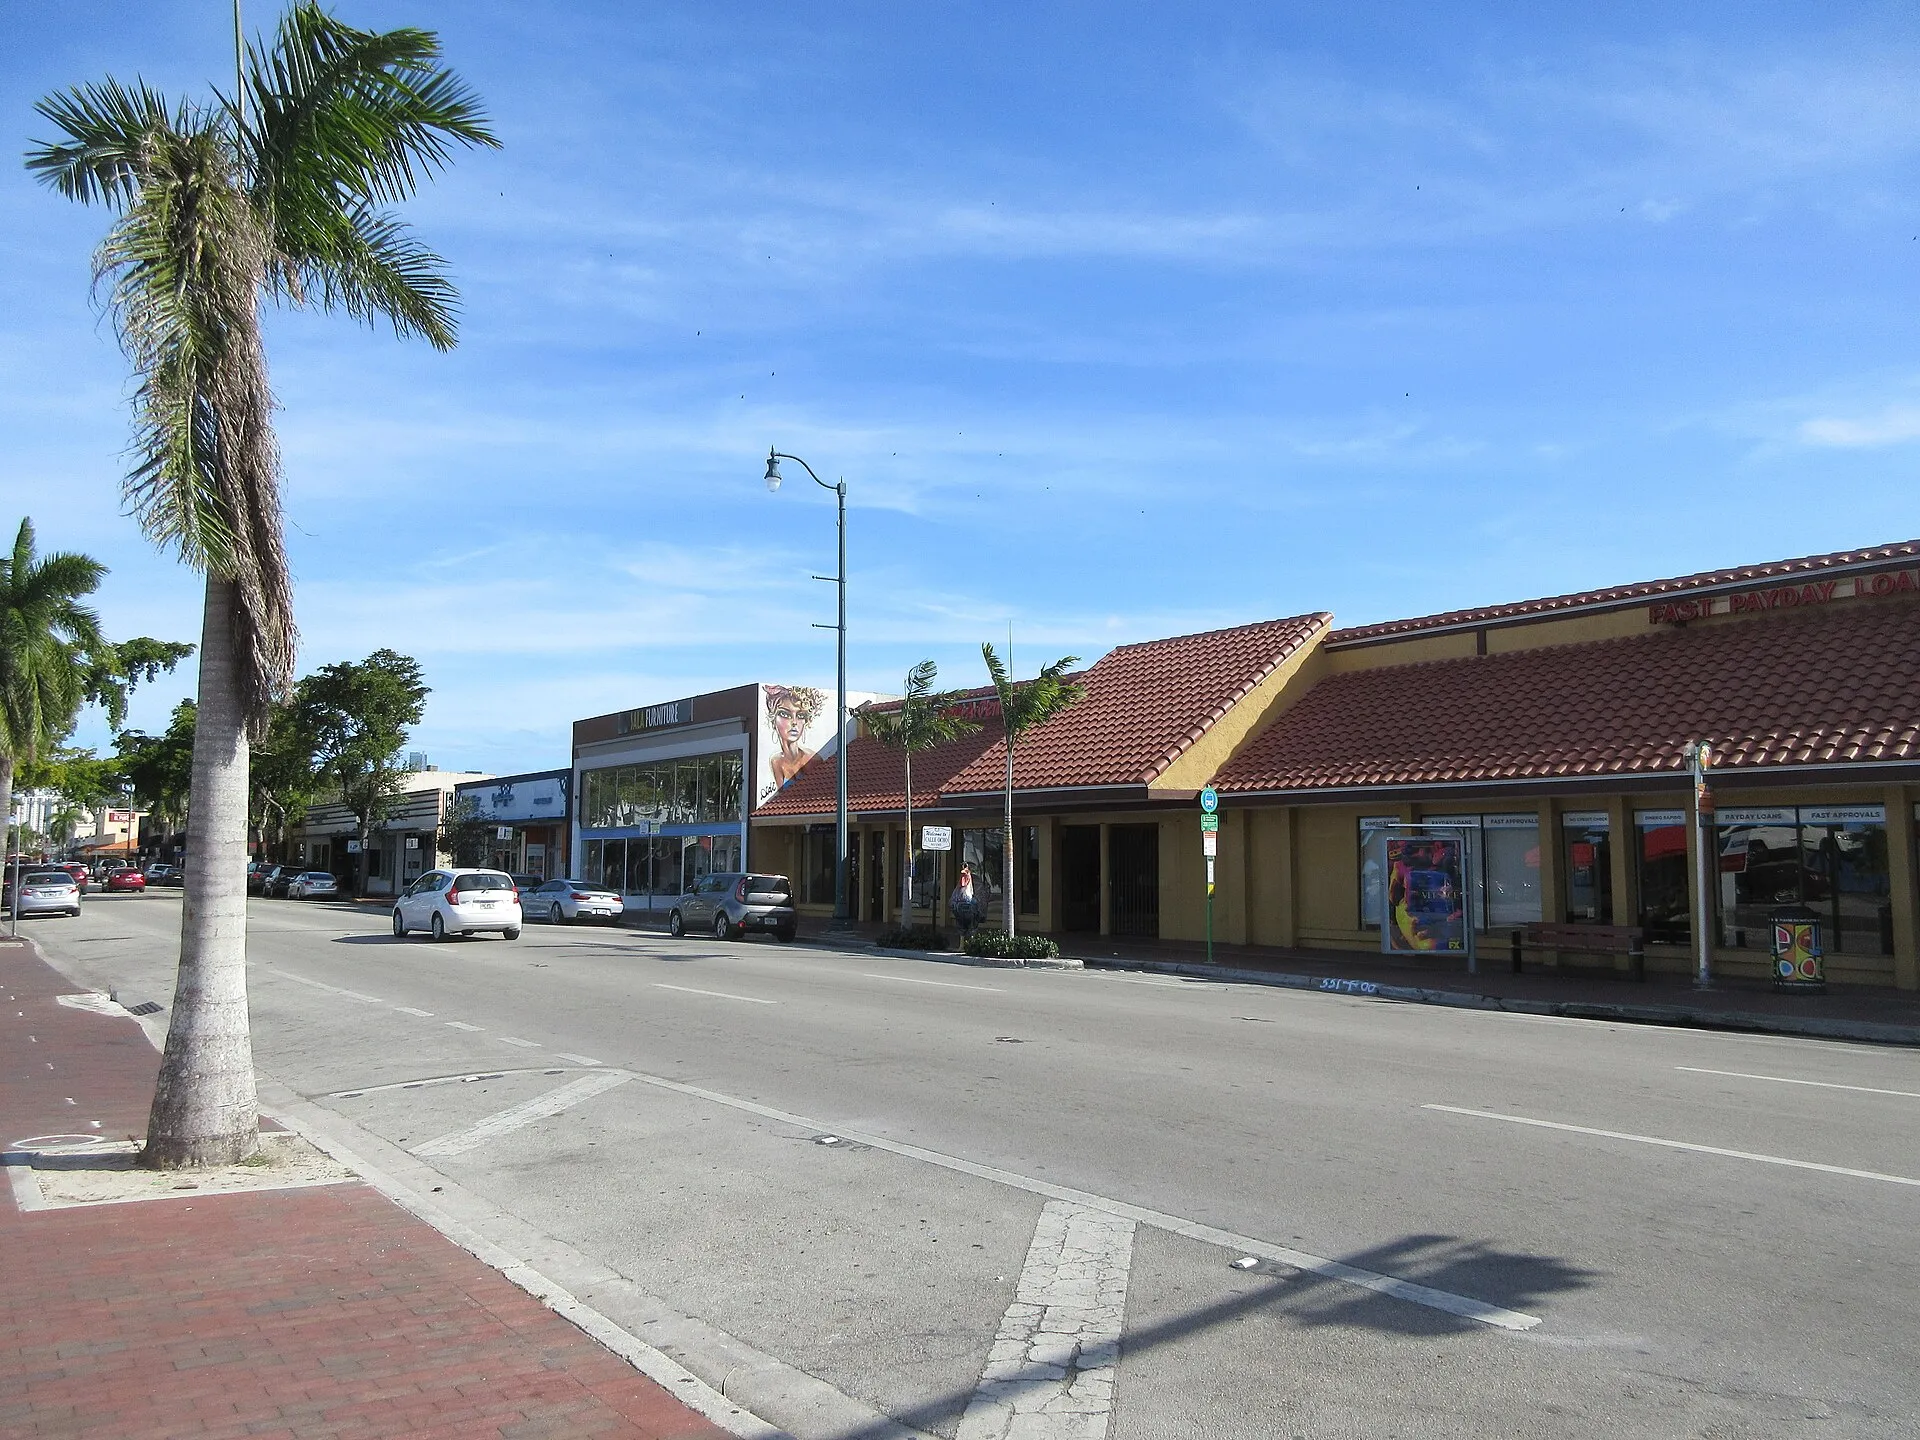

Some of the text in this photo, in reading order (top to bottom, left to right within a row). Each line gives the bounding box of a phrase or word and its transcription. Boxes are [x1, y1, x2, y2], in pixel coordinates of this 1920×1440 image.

[1649, 569, 1920, 625] FAST PAYDAY LOA
[645, 702, 679, 728] FURNITURE
[1448, 941, 1461, 949] FX
